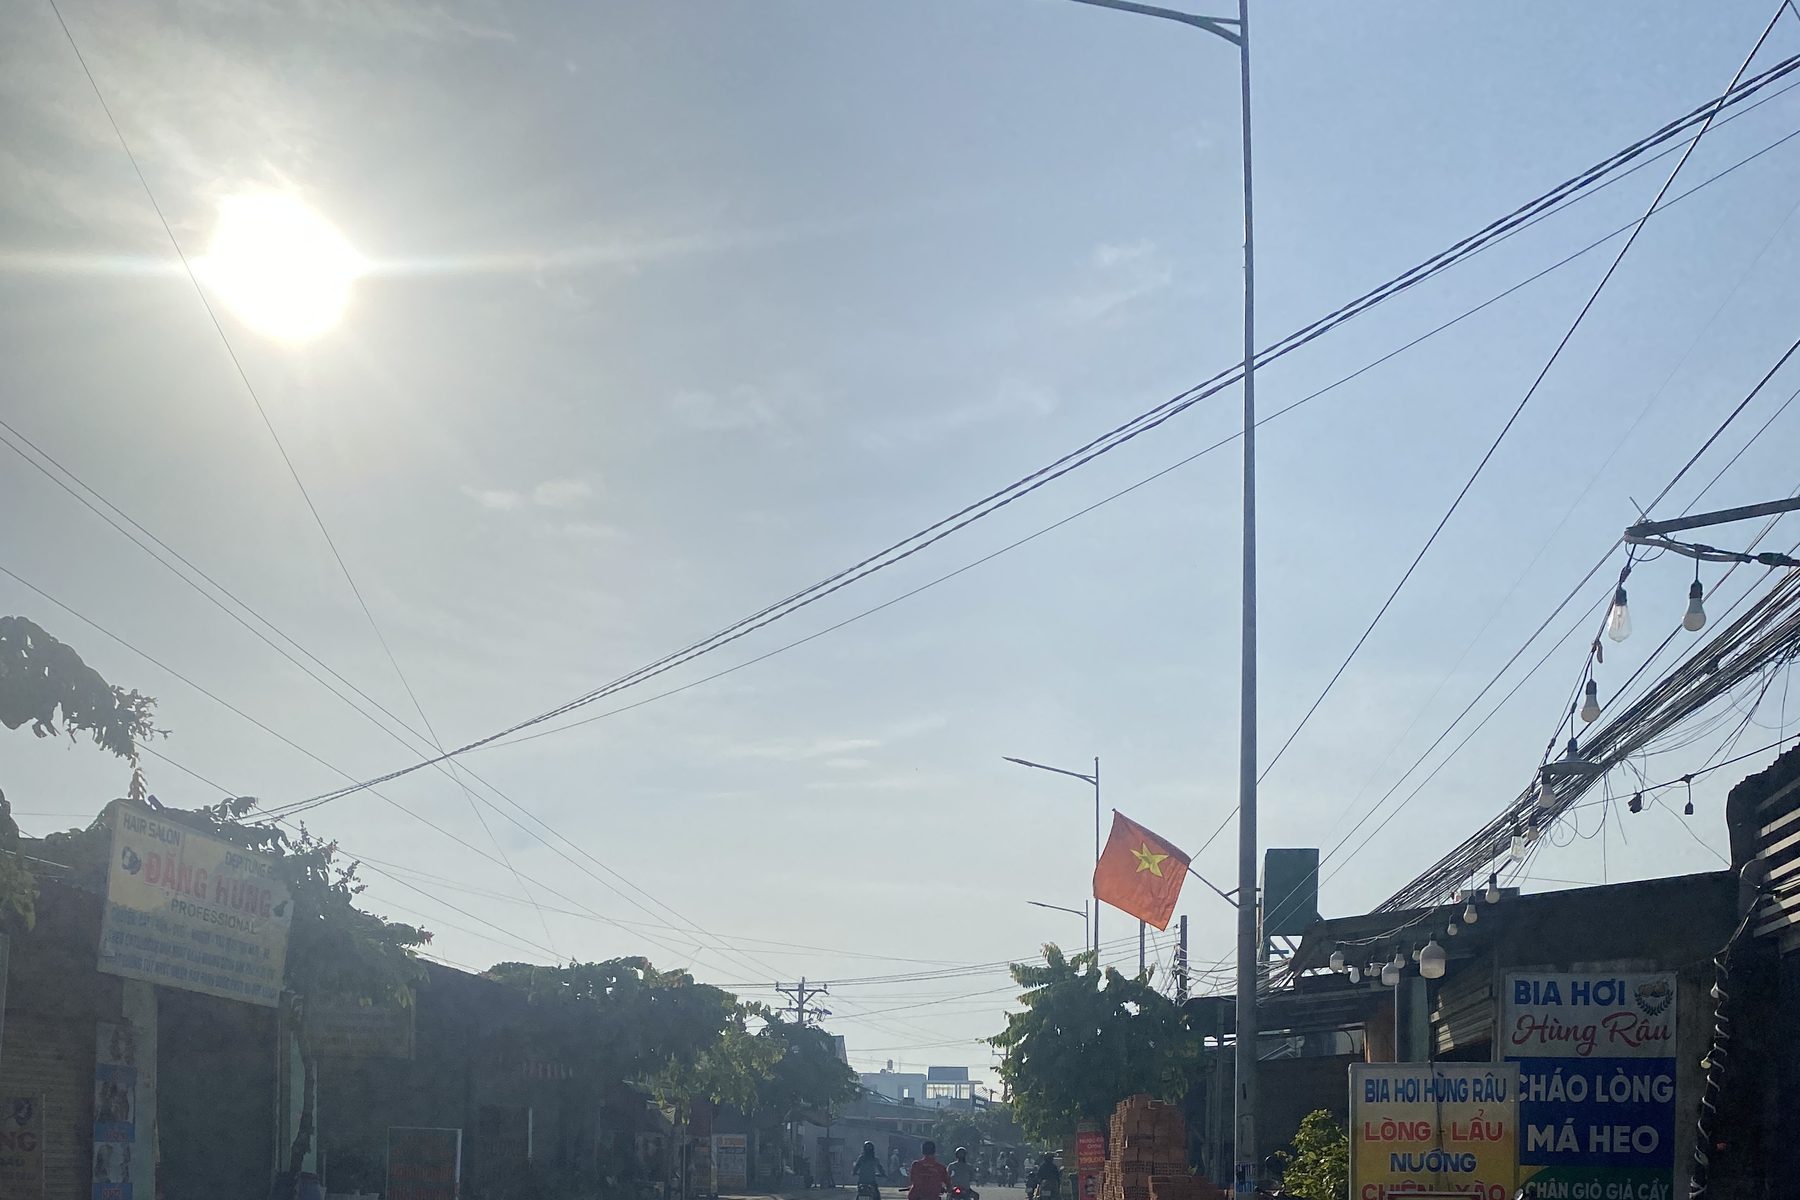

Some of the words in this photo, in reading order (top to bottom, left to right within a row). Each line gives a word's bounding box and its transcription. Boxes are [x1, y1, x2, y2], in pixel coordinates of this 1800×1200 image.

[124, 813, 147, 836] HAIR
[148, 824, 181, 847] SALON
[170, 898, 257, 935] PROFESSIONAL
[1514, 980, 1562, 1007] BIA
[1571, 978, 1626, 1007] HƠI
[1511, 1012, 1598, 1056] Hùng
[1601, 1011, 1672, 1048] Râu
[1365, 1078, 1391, 1103] BIA
[1423, 1071, 1470, 1103] HÙNG
[1472, 1071, 1507, 1103] RÂU
[1596, 1067, 1675, 1104] LÒNG
[1364, 1116, 1432, 1142] LÒNG
[1451, 1108, 1504, 1142] LẨU
[1527, 1117, 1580, 1153] MÁ
[1588, 1124, 1660, 1154] HEO
[1389, 1147, 1477, 1173] NƯỚNG
[1572, 1178, 1603, 1200] GIÒ
[1605, 1178, 1634, 1200] GIẢ
